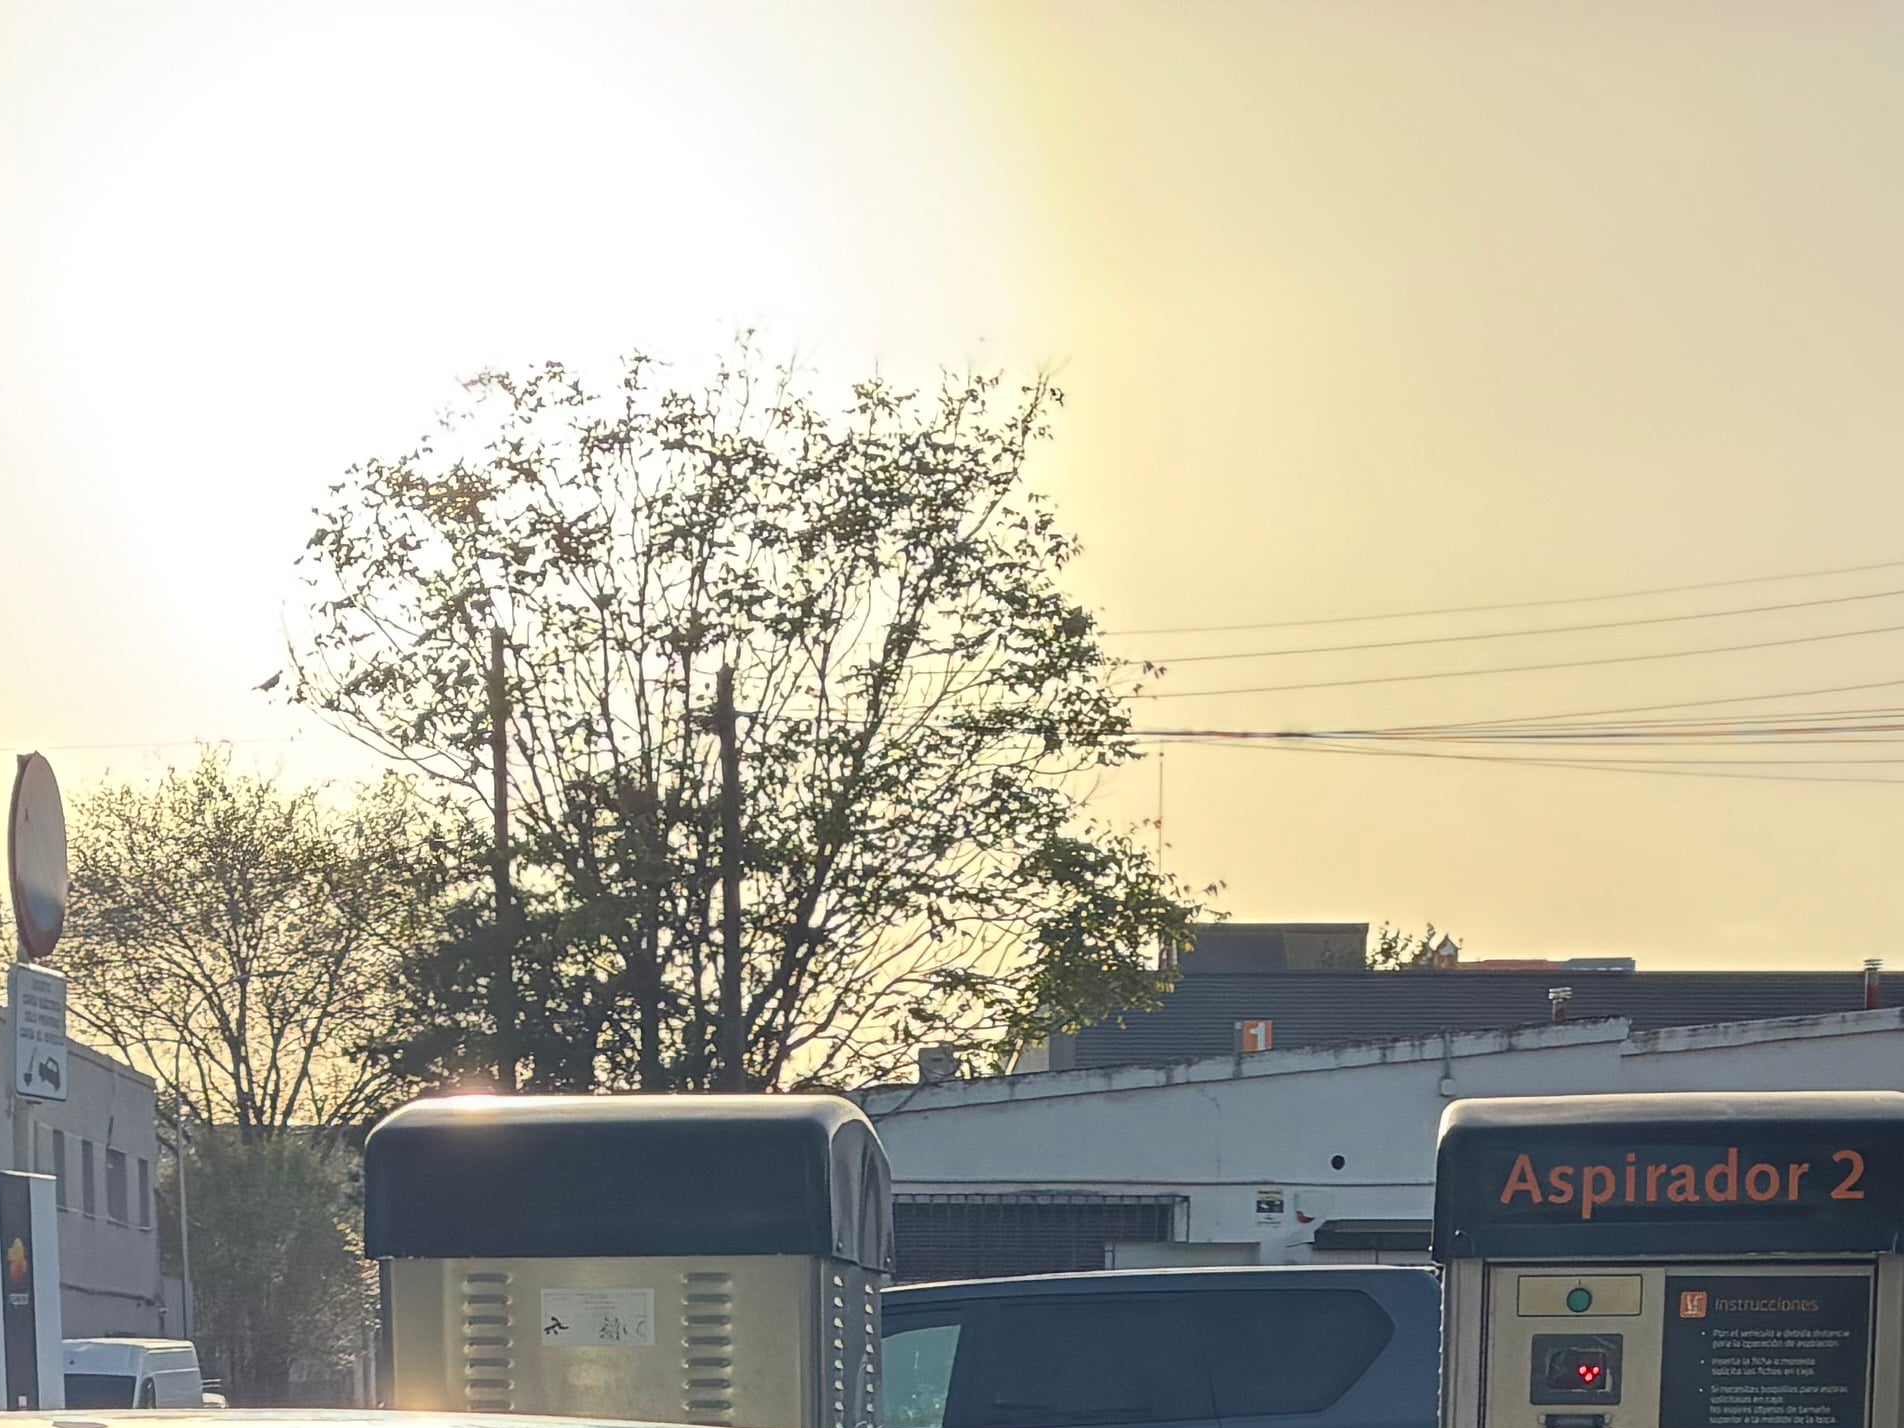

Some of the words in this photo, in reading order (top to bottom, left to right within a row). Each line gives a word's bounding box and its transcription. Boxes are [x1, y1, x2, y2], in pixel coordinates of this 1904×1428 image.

[1249, 1022, 1266, 1050] 1
[1500, 1147, 1809, 1220] Aspirador
[1830, 1149, 1865, 1200] 2
[1714, 1297, 1819, 1312] Instrucciones
